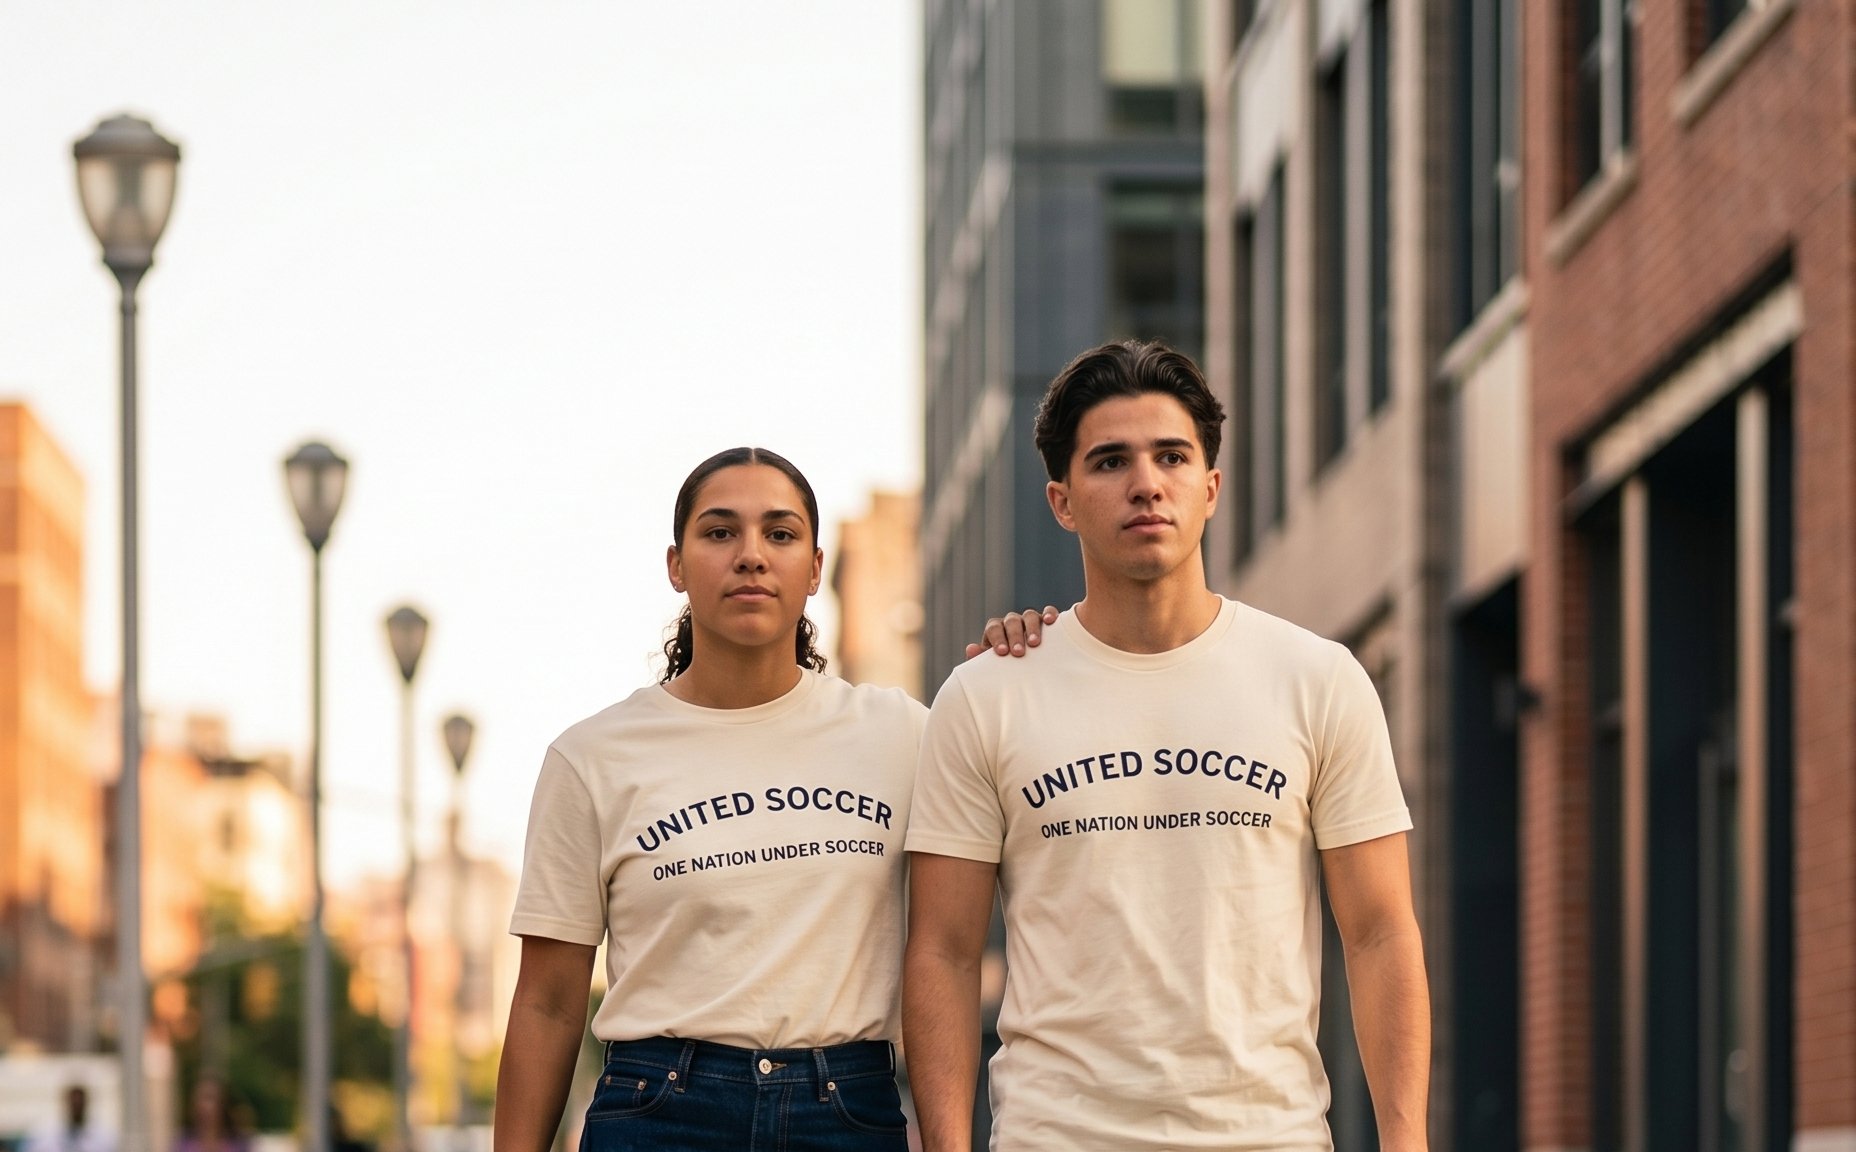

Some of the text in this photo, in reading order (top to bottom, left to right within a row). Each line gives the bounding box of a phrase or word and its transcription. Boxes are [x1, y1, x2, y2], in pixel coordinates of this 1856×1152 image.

[1021, 748, 1288, 809] UNITED SOCCER
[636, 786, 893, 852] UNITED SOCCER
[1041, 810, 1272, 839] ONE NATION UNDER SOCCER
[653, 839, 885, 881] ONE NATION UNDER SOCCER
